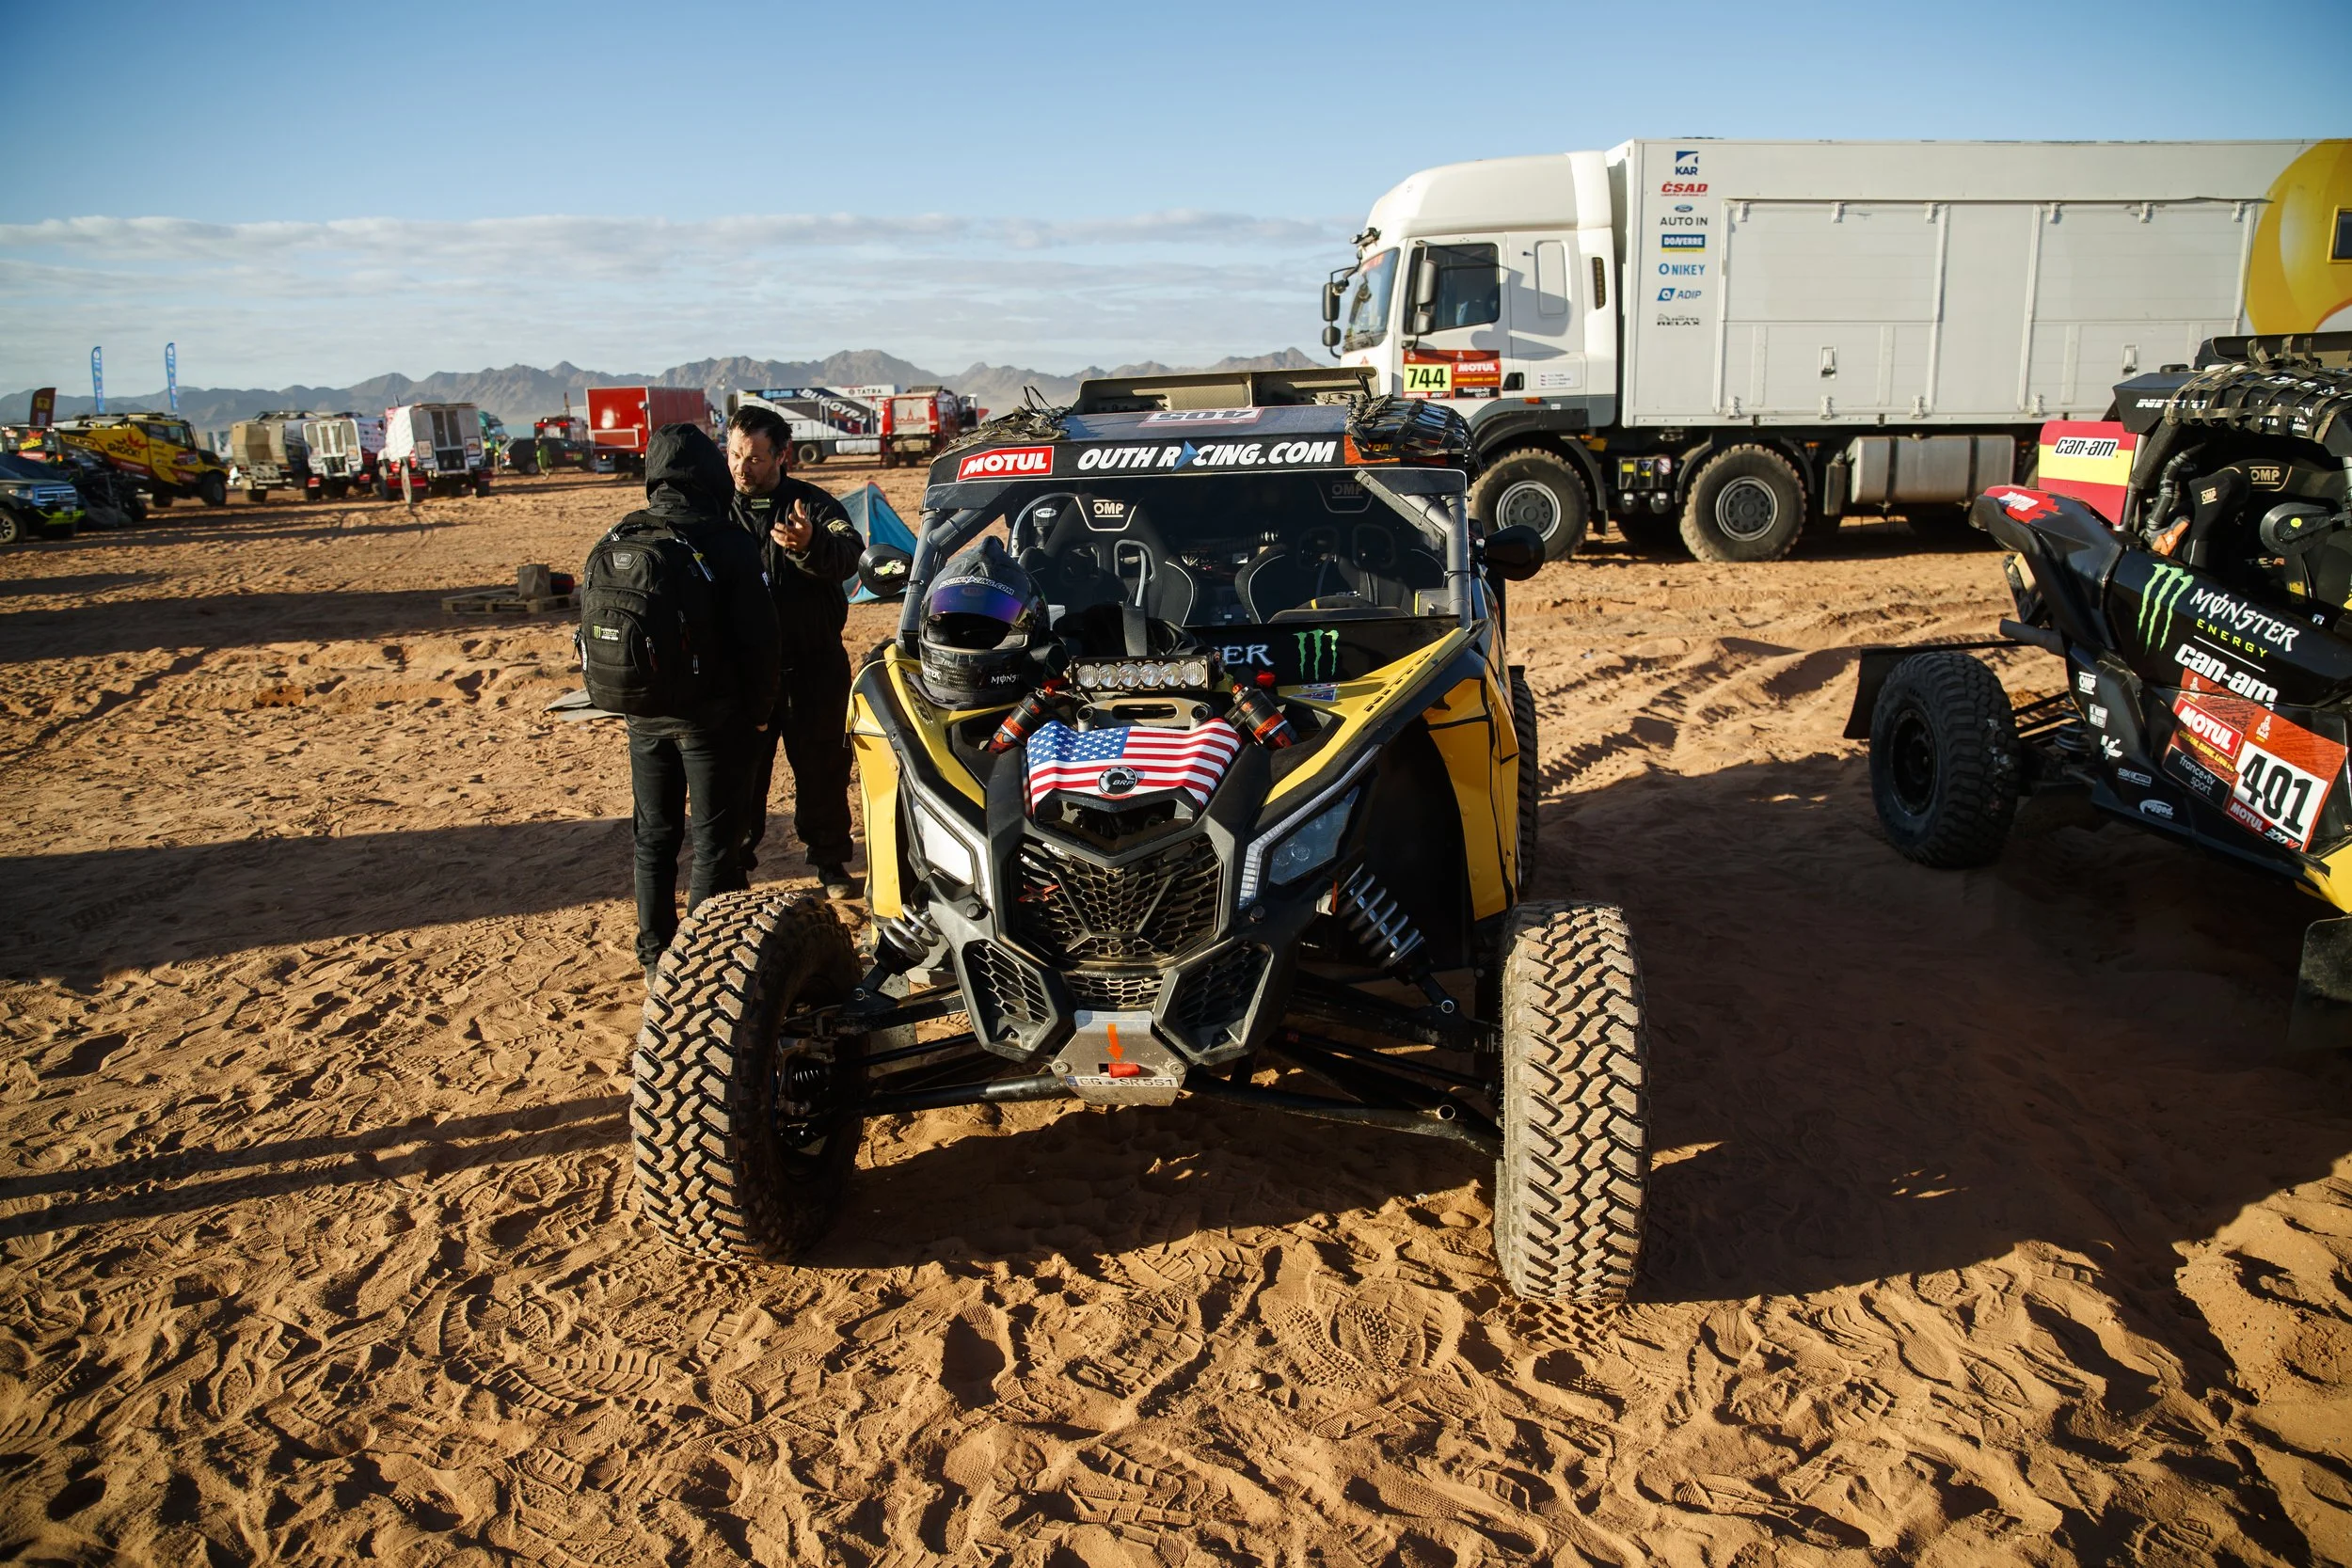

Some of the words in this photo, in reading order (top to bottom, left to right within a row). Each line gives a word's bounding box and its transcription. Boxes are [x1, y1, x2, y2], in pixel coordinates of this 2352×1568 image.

[1675, 166, 1698, 176] KAR
[1661, 181, 1708, 193] ČSAD
[1661, 217, 1693, 226] AUTO
[1696, 217, 1708, 226] IN
[1677, 290, 1702, 299] ADIP
[1457, 363, 1496, 372] MOTUL
[1408, 368, 1446, 388] 744
[962, 452, 1047, 475] MOTUL
[2250, 469, 2280, 482] OMP
[2201, 490, 2217, 502] OMP
[1093, 502, 1124, 515] OMP
[2196, 618, 2268, 657] ENERGY
[2178, 705, 2233, 751] MOTUL
[2190, 776, 2213, 796] sport
[2242, 752, 2313, 836] 401
[2230, 802, 2265, 832] MOTUL
